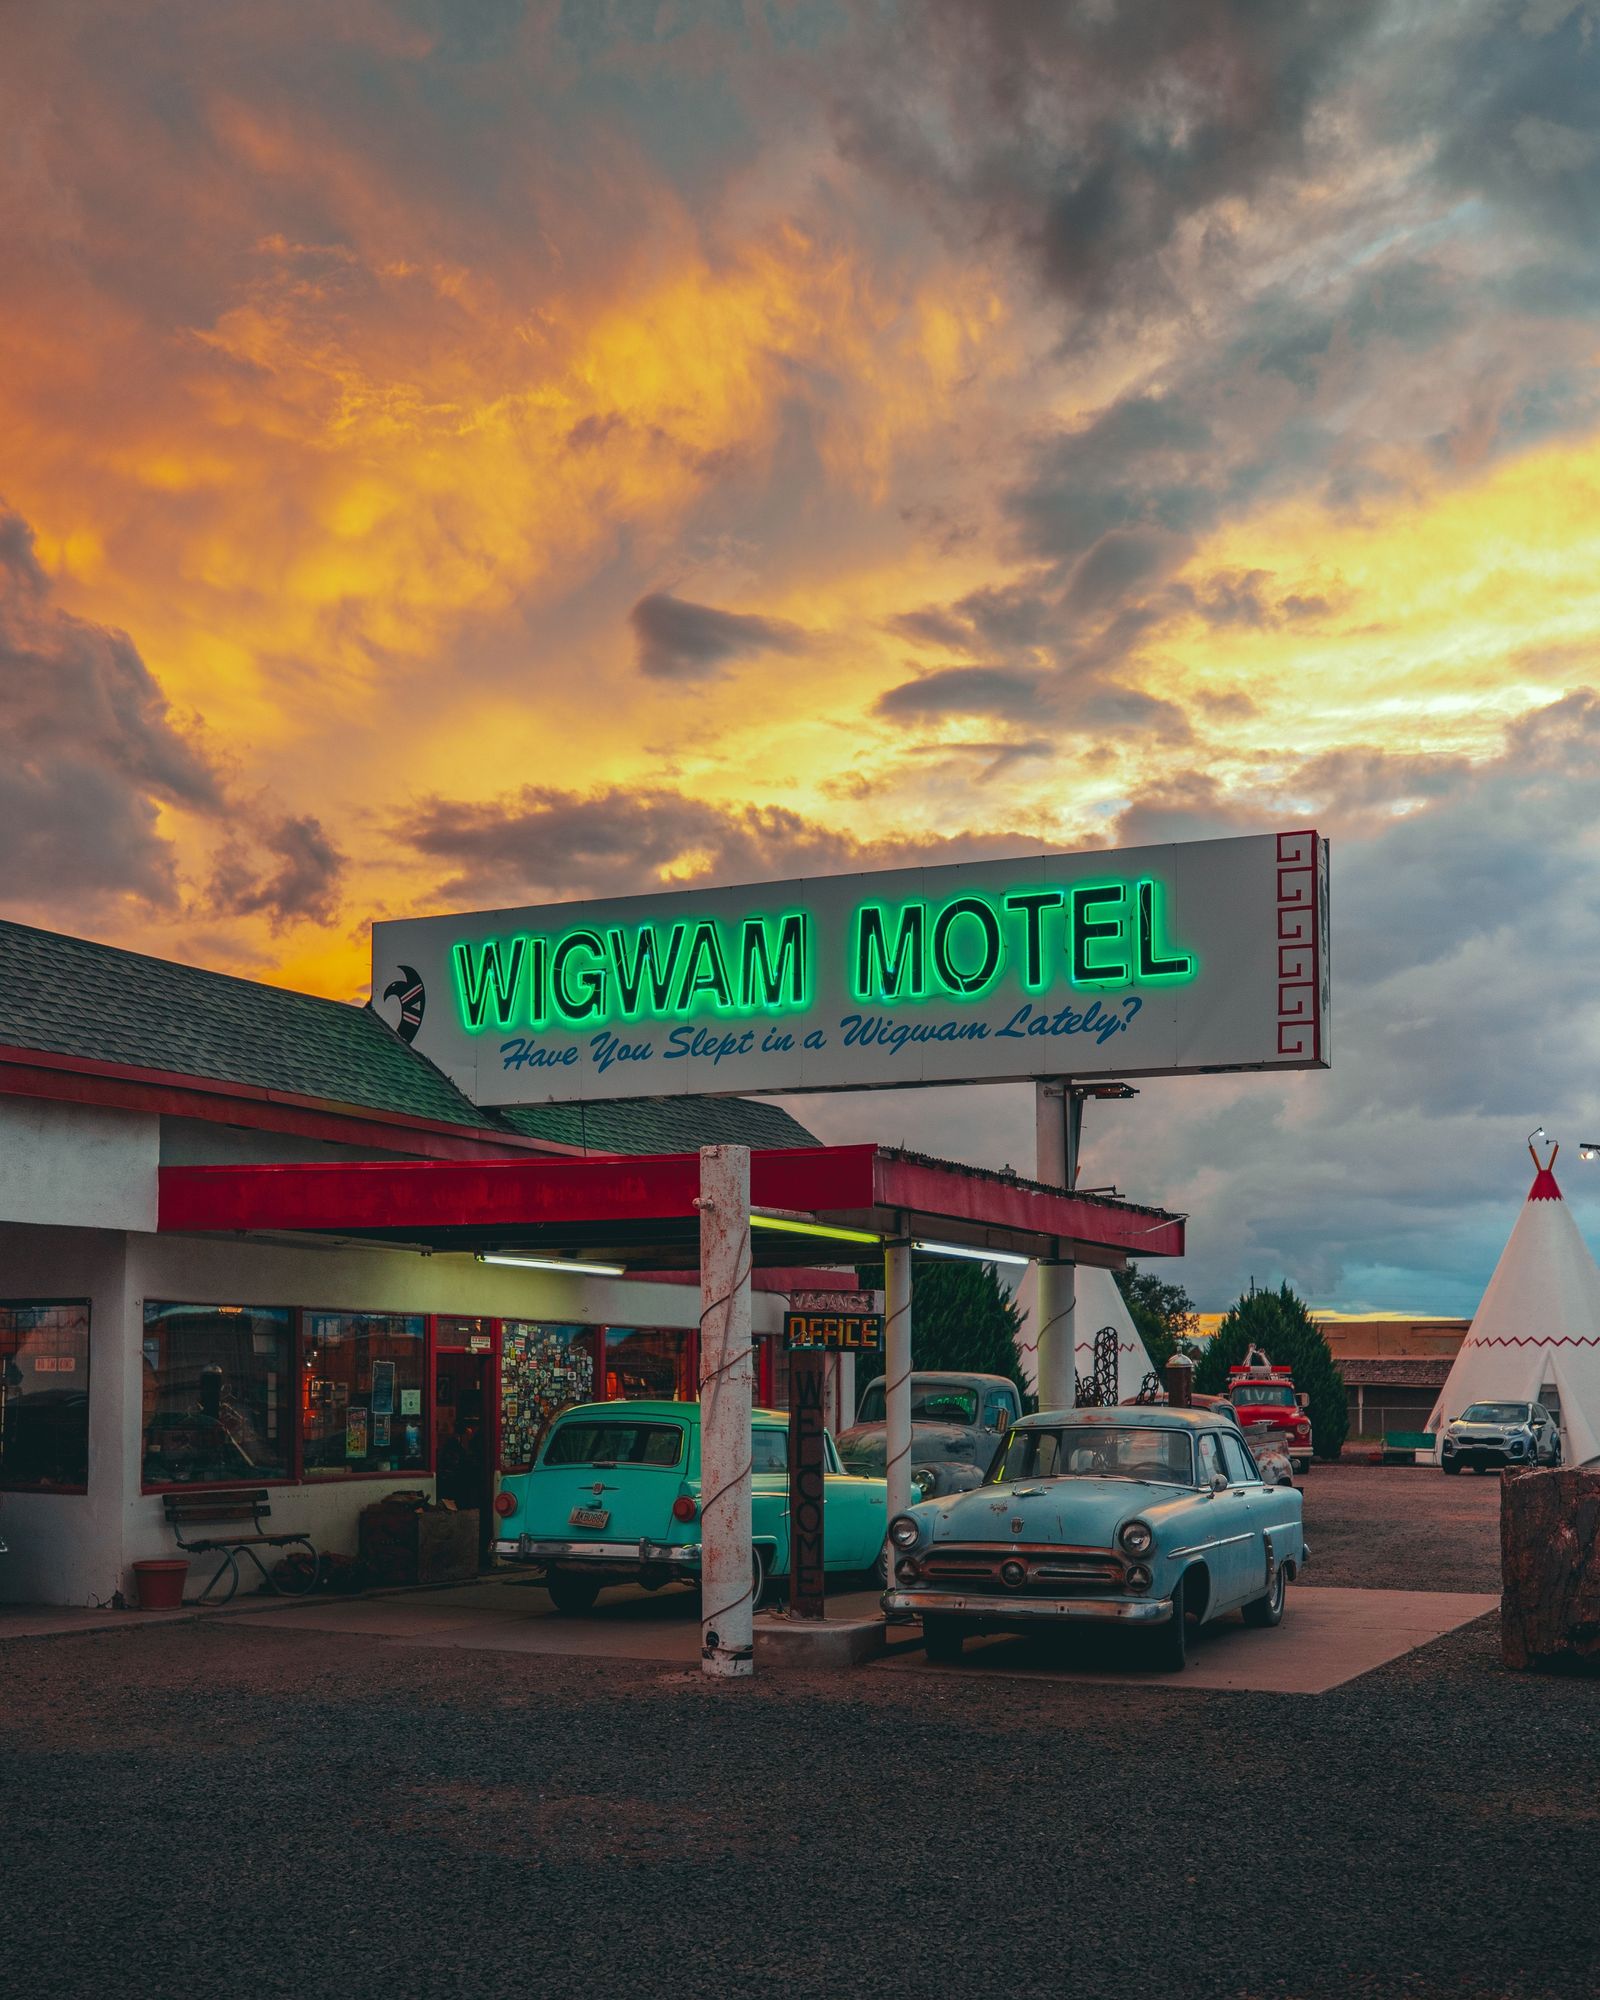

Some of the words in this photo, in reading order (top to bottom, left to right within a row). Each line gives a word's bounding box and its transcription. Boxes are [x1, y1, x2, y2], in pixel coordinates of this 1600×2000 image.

[453, 913, 807, 1028] WIGWAM
[857, 880, 1192, 997] MOTEL
[500, 1038, 578, 1070] Have
[590, 1031, 654, 1073] You
[663, 1026, 754, 1065] Slept
[762, 1022, 796, 1051] in
[803, 1028, 827, 1049] a
[840, 1014, 991, 1055] Wigwam
[996, 998, 1143, 1044] Lately?
[789, 1317, 877, 1346] OFFICE
[793, 1292, 870, 1312] VACANCY
[795, 1371, 823, 1596] WELCOME
